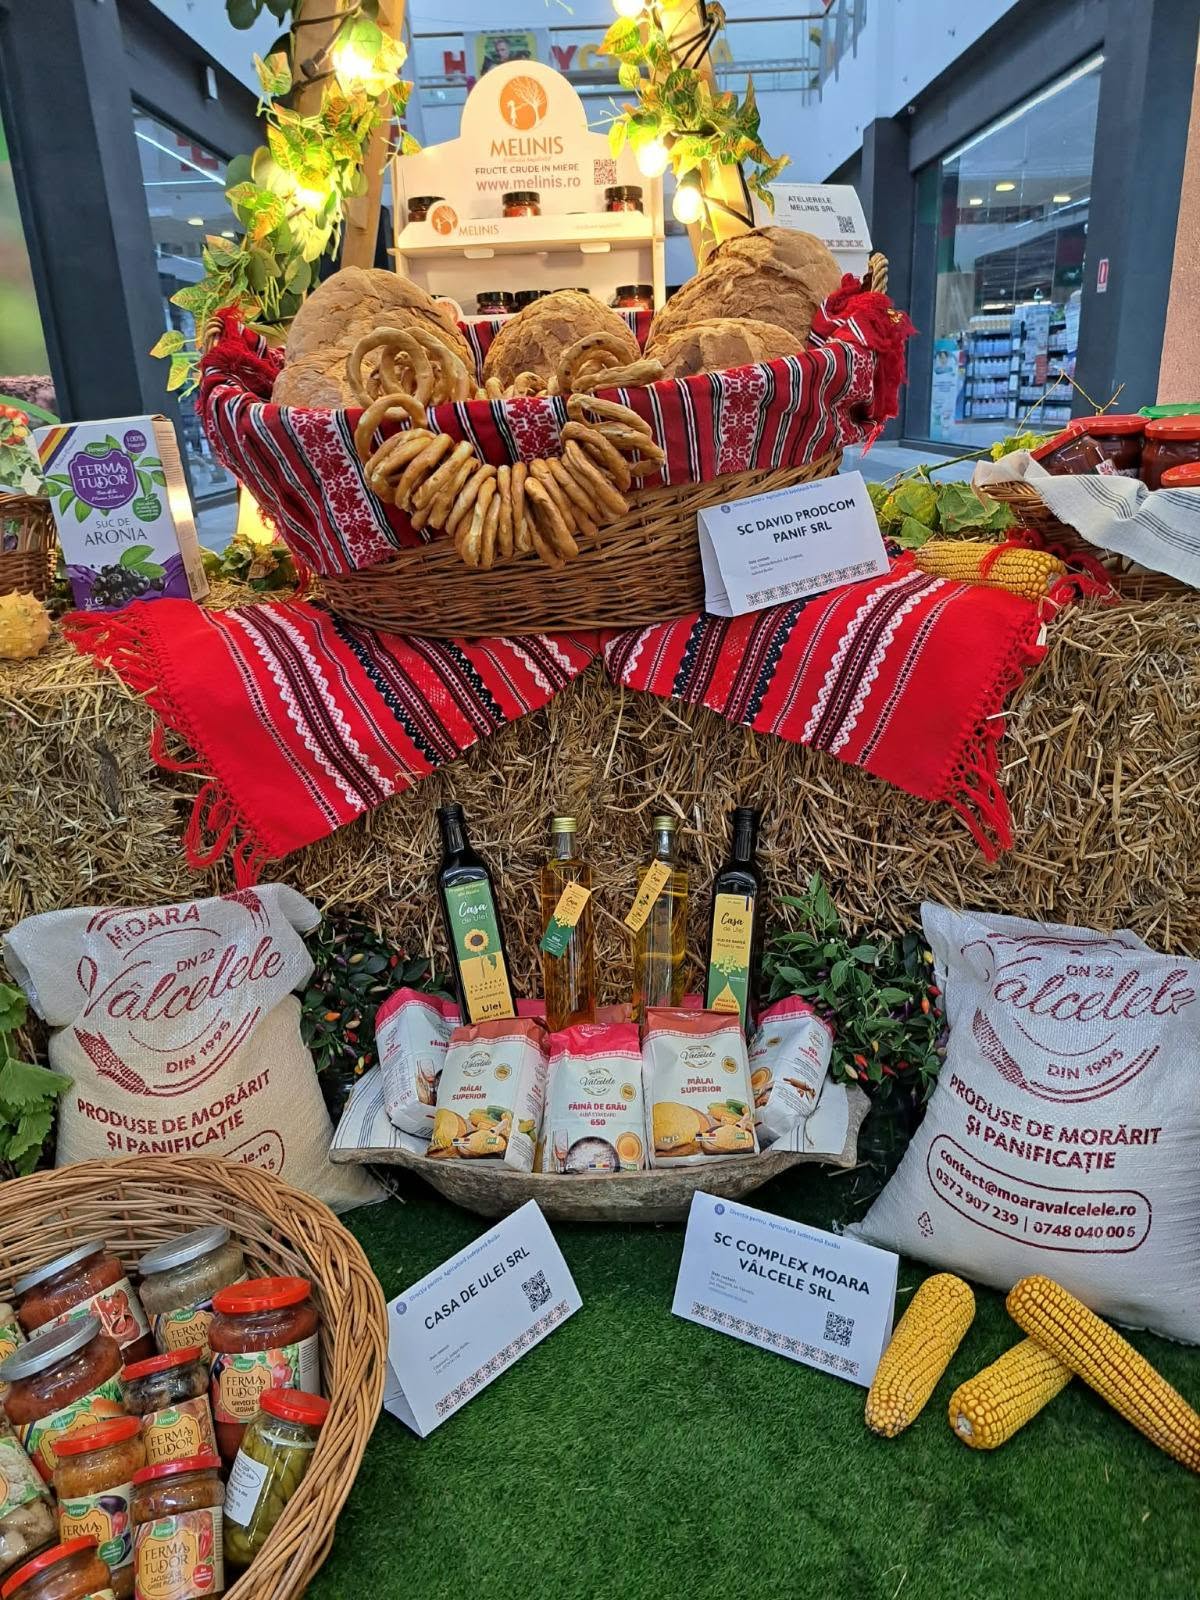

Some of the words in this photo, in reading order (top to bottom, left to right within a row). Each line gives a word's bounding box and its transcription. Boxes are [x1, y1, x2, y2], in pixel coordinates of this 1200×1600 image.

[490, 136, 564, 157] MELINIS
[475, 166, 508, 175] FRUCTE
[509, 165, 540, 174] CRUDE
[541, 164, 550, 172] IN
[552, 163, 580, 171] MIERE
[476, 175, 581, 191] www.melinis.ro
[788, 195, 832, 204] ATELIERELE
[790, 204, 820, 212] MELINIS
[821, 205, 836, 213] SRL
[459, 224, 500, 237] MELINIS
[77, 462, 127, 476] FERMA
[78, 474, 129, 489] TUDOR
[95, 518, 115, 529] SUC
[117, 517, 131, 527] DE
[737, 523, 755, 536] SC
[756, 513, 794, 532] DAVID
[796, 498, 856, 521] PRODCOM
[84, 528, 148, 547] ARONIA
[773, 526, 808, 544] PANIF
[810, 520, 832, 535] SRL
[458, 901, 488, 917] Casa
[720, 912, 745, 926] Casa
[107, 904, 200, 949] MOARA
[176, 955, 198, 973] DN
[200, 948, 215, 965] 22
[77, 936, 286, 1021] Vâlcelele
[482, 1001, 502, 1012] Ulei
[166, 1055, 196, 1074] DIN
[200, 1020, 231, 1056] 1995
[1047, 1063, 1080, 1079] DIN
[1085, 1049, 1124, 1076] 1995
[452, 1093, 487, 1101] SUPERIOR
[681, 1086, 722, 1094] SUPERIOR
[77, 1098, 158, 1135] PRODUSE
[162, 1115, 189, 1134] DE
[191, 1068, 270, 1128] MORĂRIT
[593, 1103, 604, 1111] DE
[950, 1073, 1023, 1132] PRODUSE
[1026, 1118, 1055, 1142] DE
[1058, 1124, 1162, 1146] MORĂRIT
[106, 1131, 123, 1151] ȘI
[126, 1110, 245, 1155] PANIFICAȚIE
[966, 1114, 981, 1137] ȘI
[983, 1125, 1116, 1174] PANIFICAȚIE
[940, 1148, 1137, 1217] contact@moaravalcelele.ro
[936, 1167, 964, 1199] 0372
[965, 1191, 989, 1213] 907
[992, 1206, 1019, 1226] 239
[1033, 1221, 1072, 1237] 0748
[1074, 1226, 1104, 1239] 040
[713, 1232, 733, 1247] SC
[736, 1239, 808, 1273] COMPLEX
[812, 1264, 870, 1294] MOARA
[424, 1298, 460, 1330] CASA
[460, 1283, 479, 1304] DE
[478, 1262, 506, 1289] ULEI
[506, 1246, 531, 1268] SRL
[739, 1258, 803, 1291] VÂLCELE
[808, 1283, 836, 1302] SRL
[171, 1321, 207, 1339] FERMA
[226, 1376, 266, 1387] FERMA
[150, 1426, 194, 1447] FERMA
[152, 1437, 194, 1458] TUDOR
[63, 1521, 102, 1537] FERMA
[145, 1541, 190, 1561] FERMA
[144, 1555, 188, 1575] TUDOR
